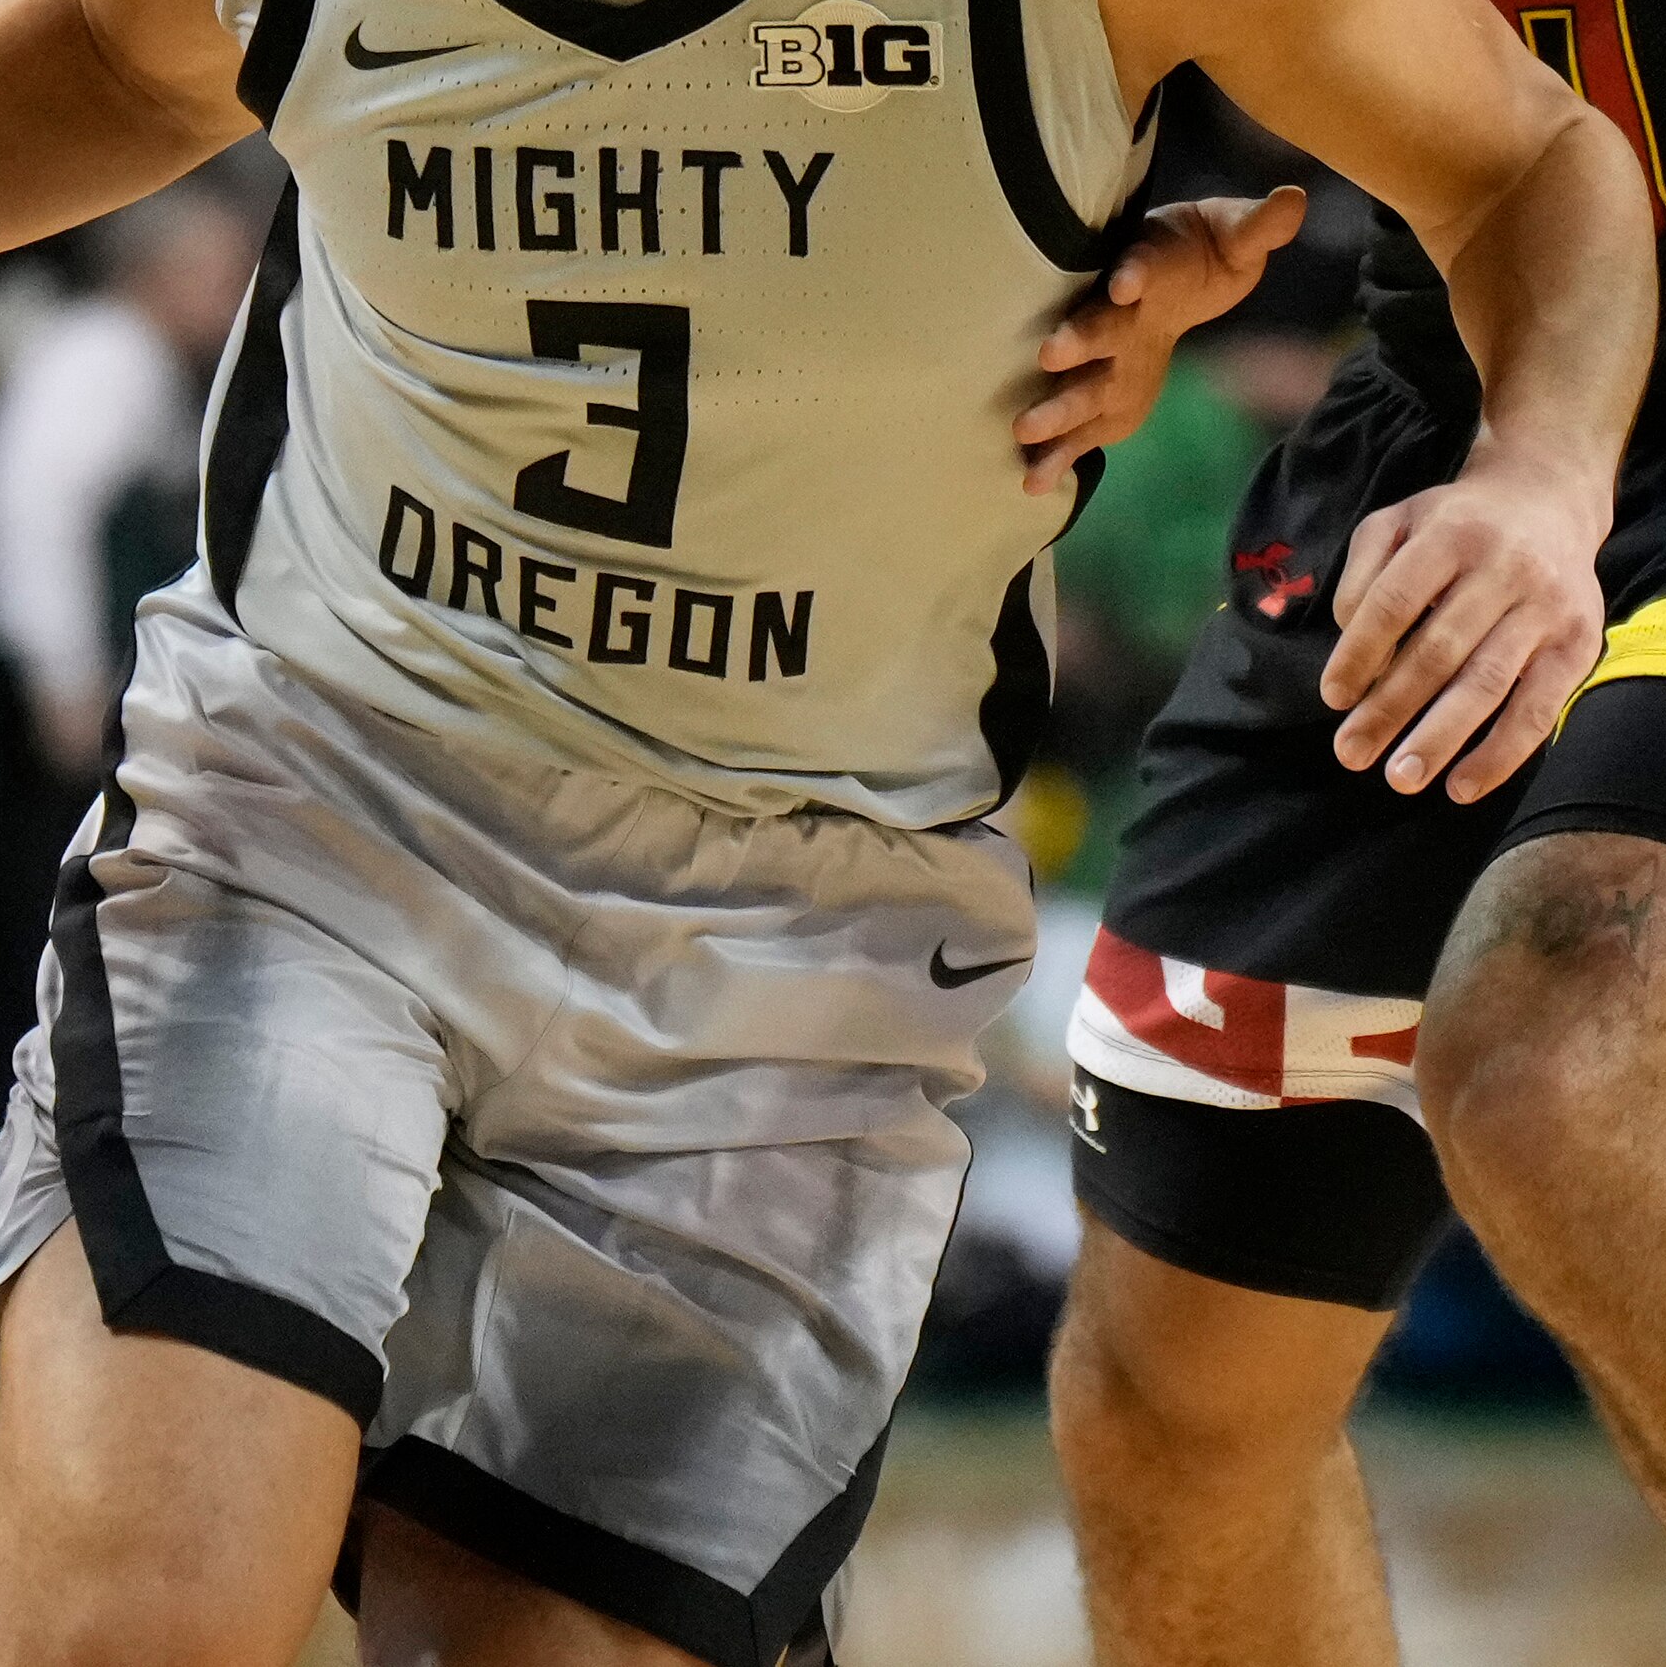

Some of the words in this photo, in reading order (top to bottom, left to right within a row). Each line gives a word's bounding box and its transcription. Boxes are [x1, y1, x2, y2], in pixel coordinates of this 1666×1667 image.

[387, 139, 835, 258] MIGHTY
[514, 299, 690, 550] 3
[378, 485, 815, 682] OREGON
